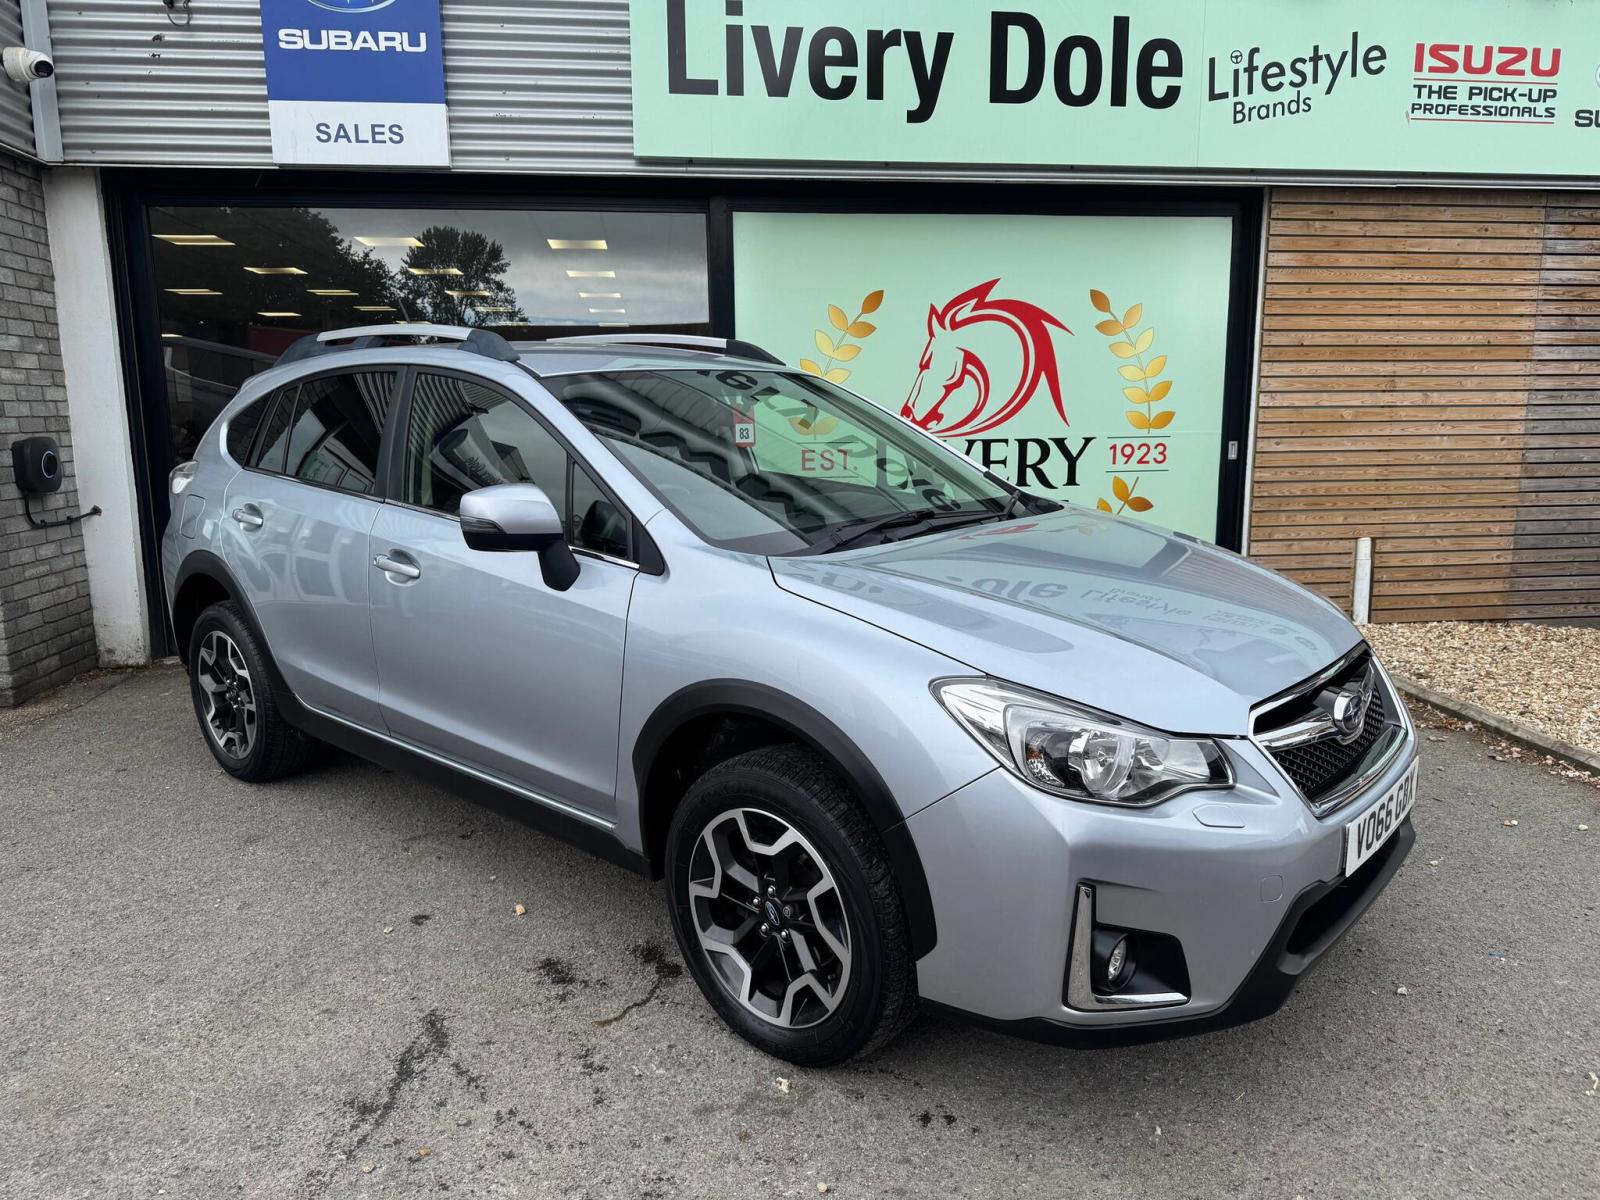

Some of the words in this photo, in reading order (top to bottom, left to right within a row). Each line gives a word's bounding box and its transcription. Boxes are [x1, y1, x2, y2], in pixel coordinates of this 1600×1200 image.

[278, 28, 427, 52] SUBARU
[666, 0, 954, 123] Livery
[989, 11, 1183, 109] Dole
[1208, 31, 1388, 102] Lifestyle
[1413, 43, 1562, 77] ISUZU
[1412, 84, 1458, 101] THE
[1467, 87, 1558, 104] PICK-UP
[1232, 91, 1312, 125] Brands
[1410, 103, 1556, 119] PROFESSIONALS
[315, 122, 404, 144] SALES
[1108, 442, 1168, 465] 1923
